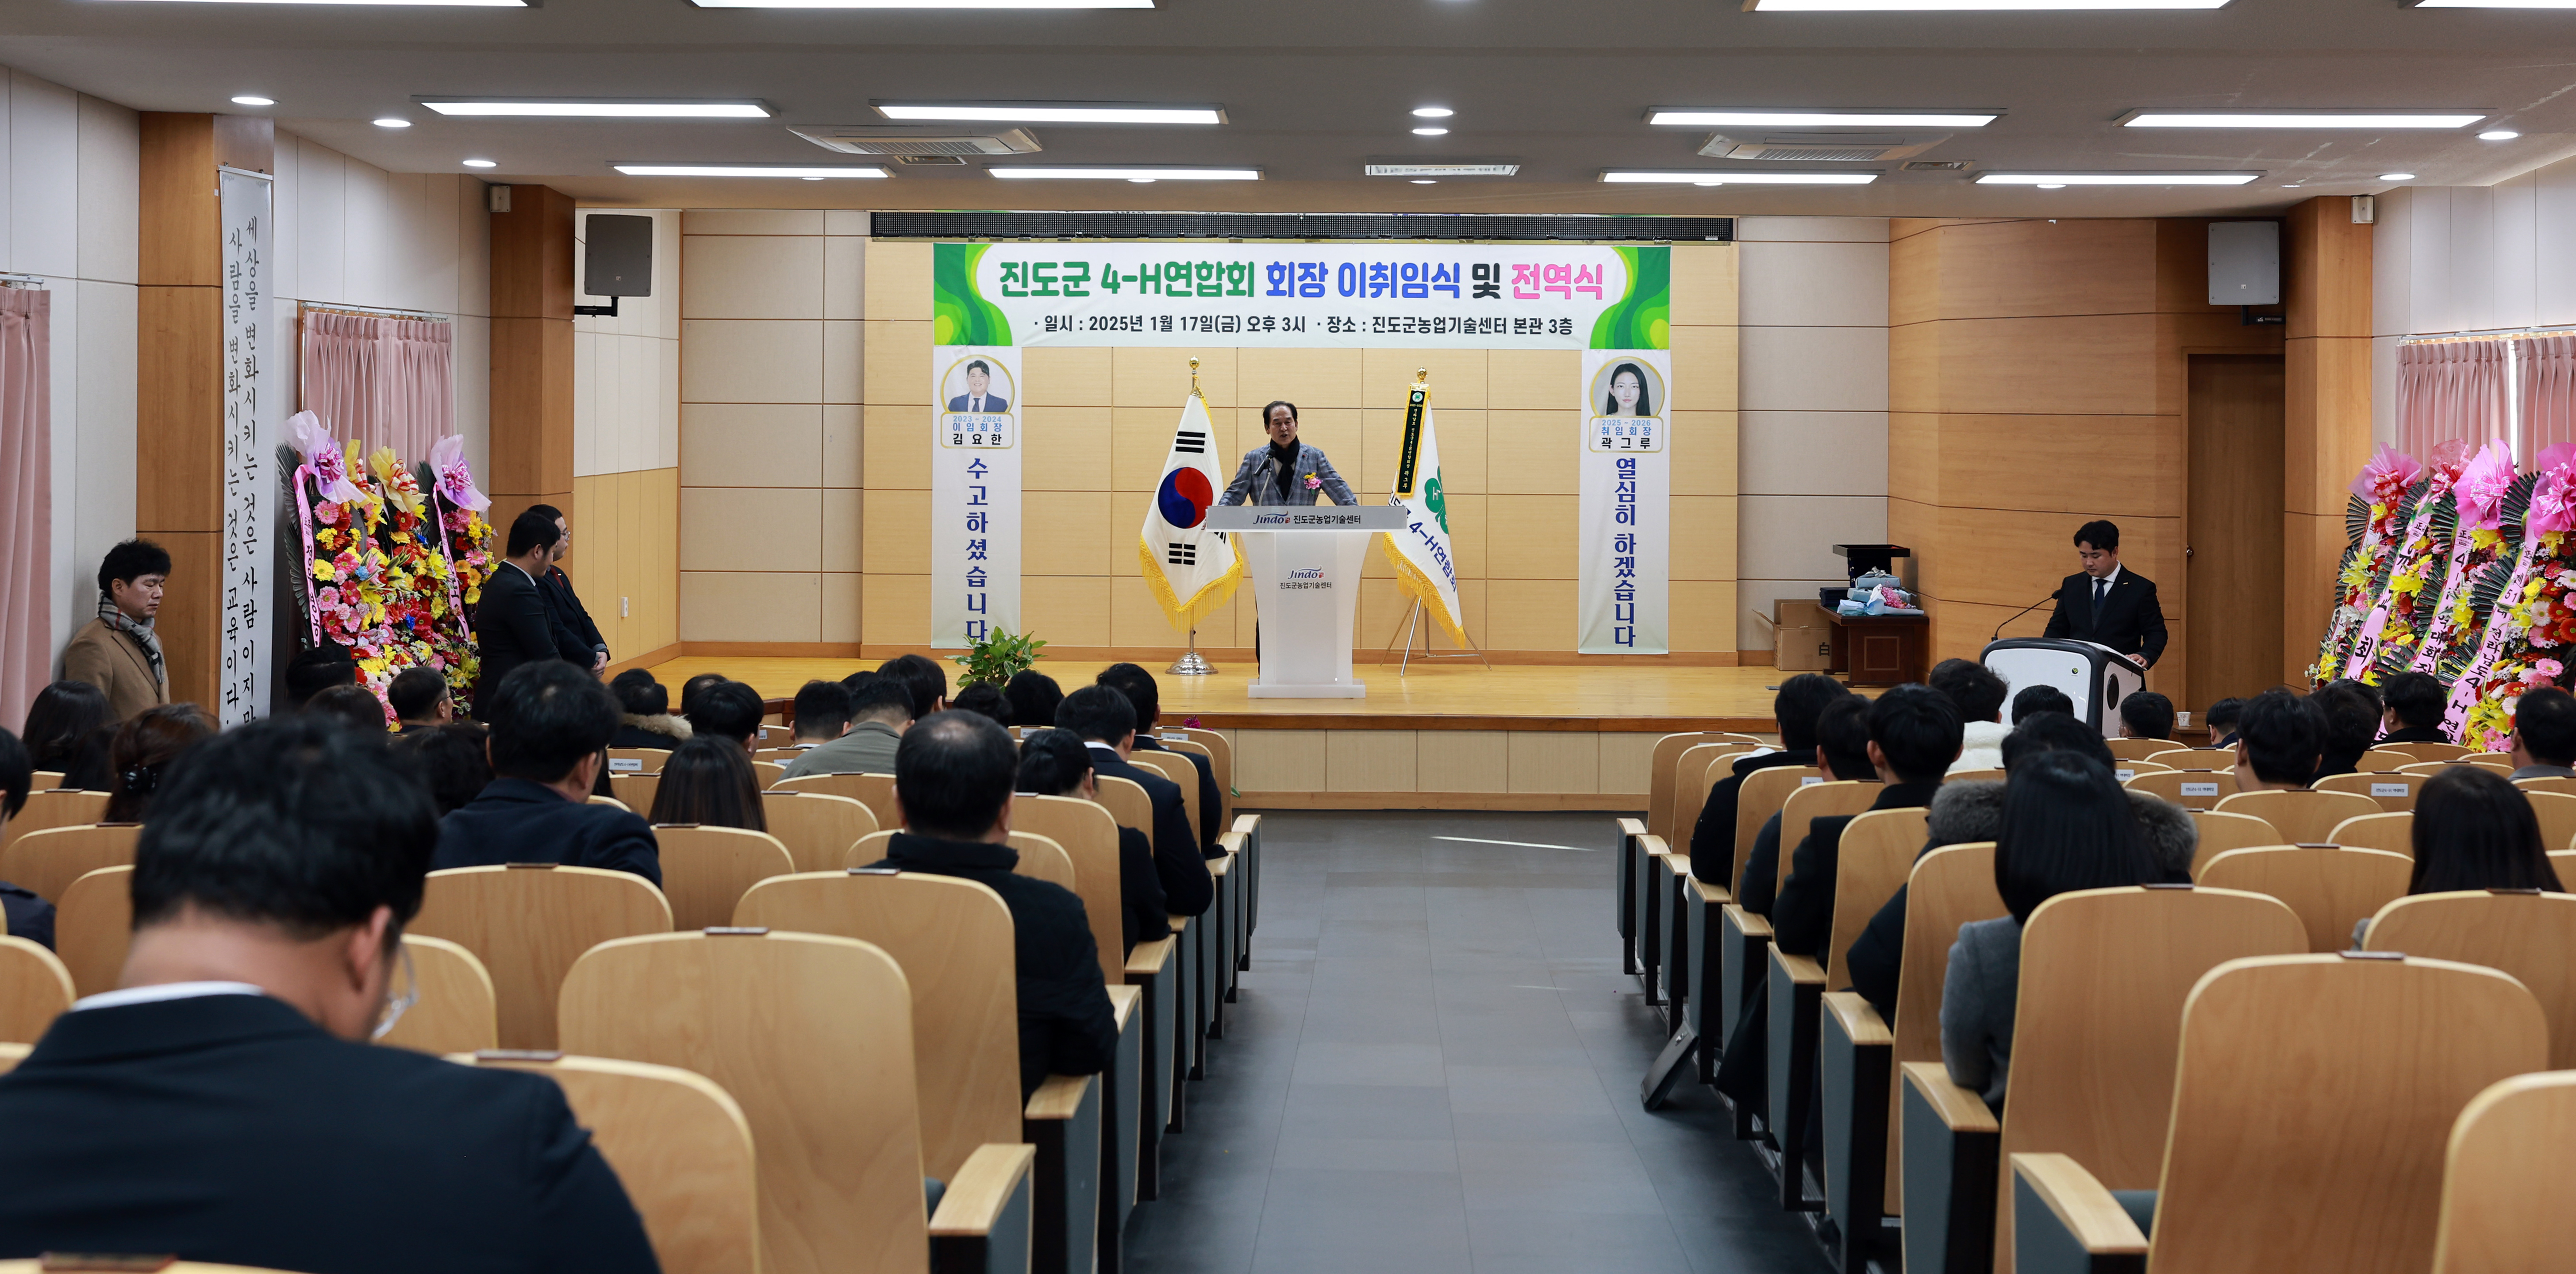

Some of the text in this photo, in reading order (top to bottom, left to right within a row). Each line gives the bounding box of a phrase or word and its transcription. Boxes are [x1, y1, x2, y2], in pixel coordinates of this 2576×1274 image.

[229, 227, 242, 324] 사람을
[245, 216, 259, 311] 세상을
[1000, 261, 1602, 300] 진도군 4-H연합회 회장 이취임식 및 전역식
[1045, 315, 1072, 332] 일시
[1089, 316, 1142, 331] 2025년
[1151, 316, 1172, 332] 1월
[1181, 315, 1241, 333] 17일(금)
[1247, 316, 1276, 332] 오후
[1282, 316, 1305, 332] 3시
[1327, 316, 1356, 333] 장소
[1373, 317, 1506, 334] 진도군농업기술센터
[1514, 318, 1543, 334] 본관
[1549, 318, 1573, 335] 3층
[227, 335, 241, 497] 변화시키는
[243, 322, 259, 481] 변화시키는
[227, 508, 239, 572] 것은
[242, 493, 258, 555] 것은
[966, 458, 988, 641] 수고하셨습니다
[1253, 514, 1284, 525] Jindo
[1293, 515, 1361, 524] 진도군농업기술센터
[1614, 458, 1637, 647] 열심히 하겠습니다
[1288, 570, 1318, 580] Jindo
